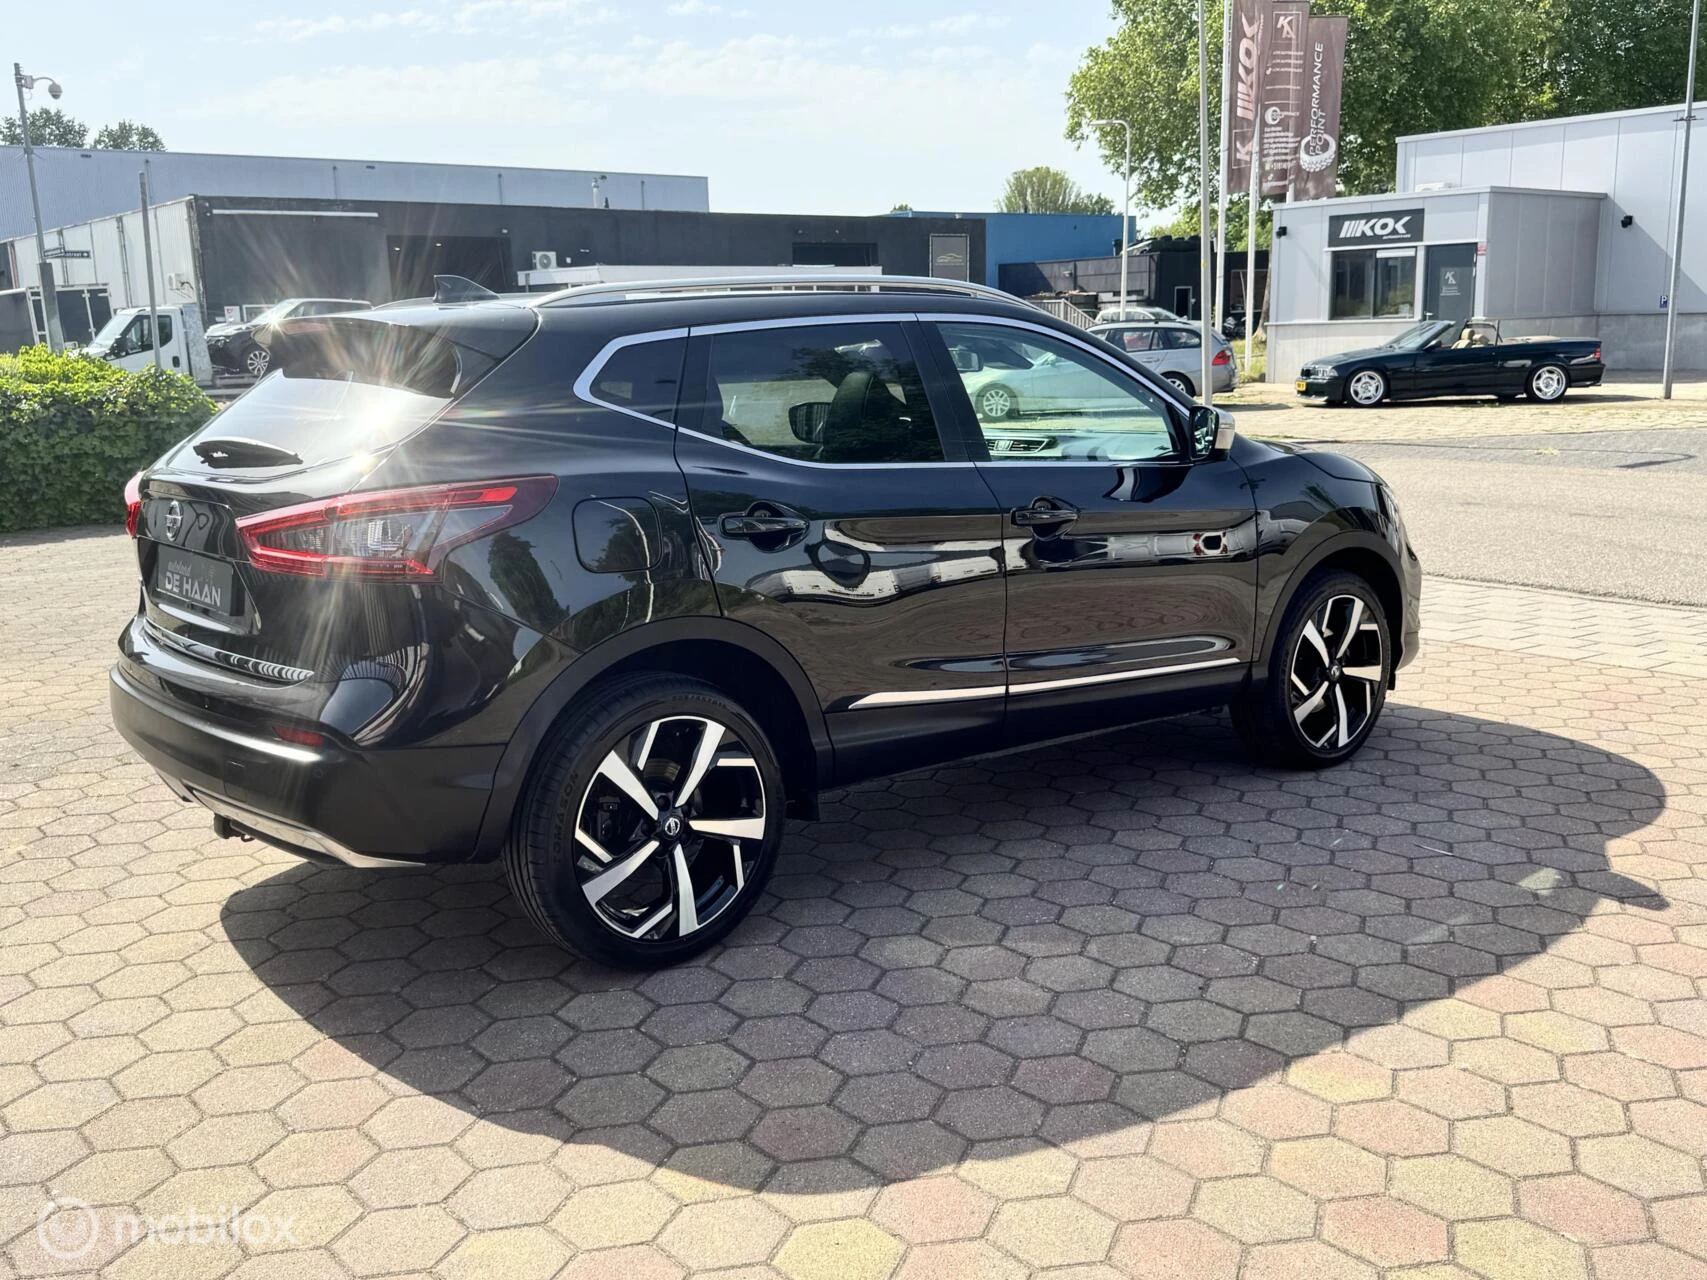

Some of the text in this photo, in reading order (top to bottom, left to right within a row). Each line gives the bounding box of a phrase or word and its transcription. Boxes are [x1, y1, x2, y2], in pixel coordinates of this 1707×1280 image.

[1309, 42, 1324, 156] PERFORMANCE
[1315, 109, 1327, 155] POINT
[165, 571, 221, 607] DE HAAN
